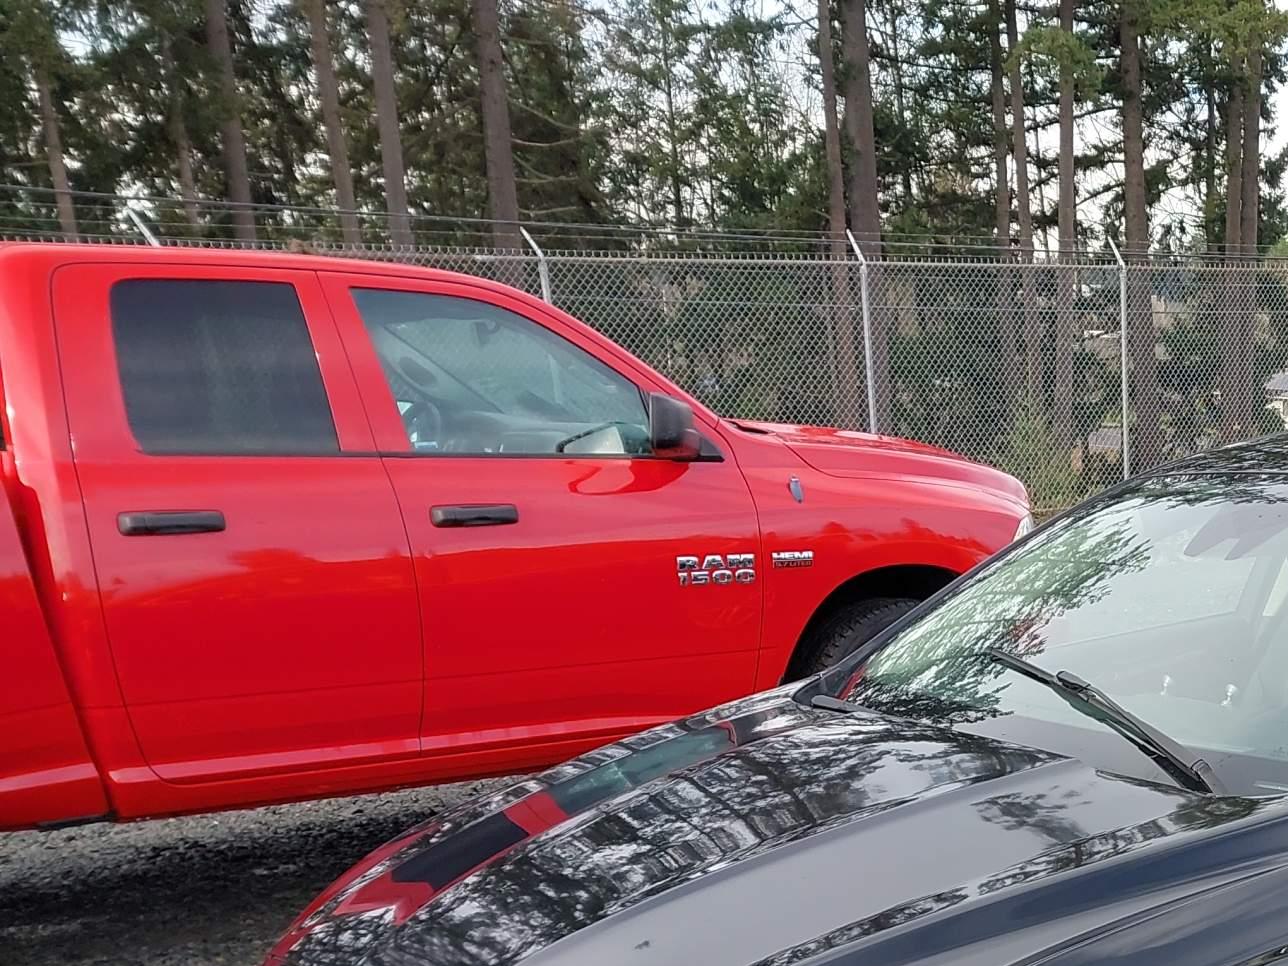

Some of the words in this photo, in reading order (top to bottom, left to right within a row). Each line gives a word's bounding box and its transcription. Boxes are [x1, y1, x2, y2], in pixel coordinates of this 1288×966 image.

[676, 553, 755, 570] RAM
[771, 551, 814, 560] HEMI
[678, 569, 756, 586] 1500
